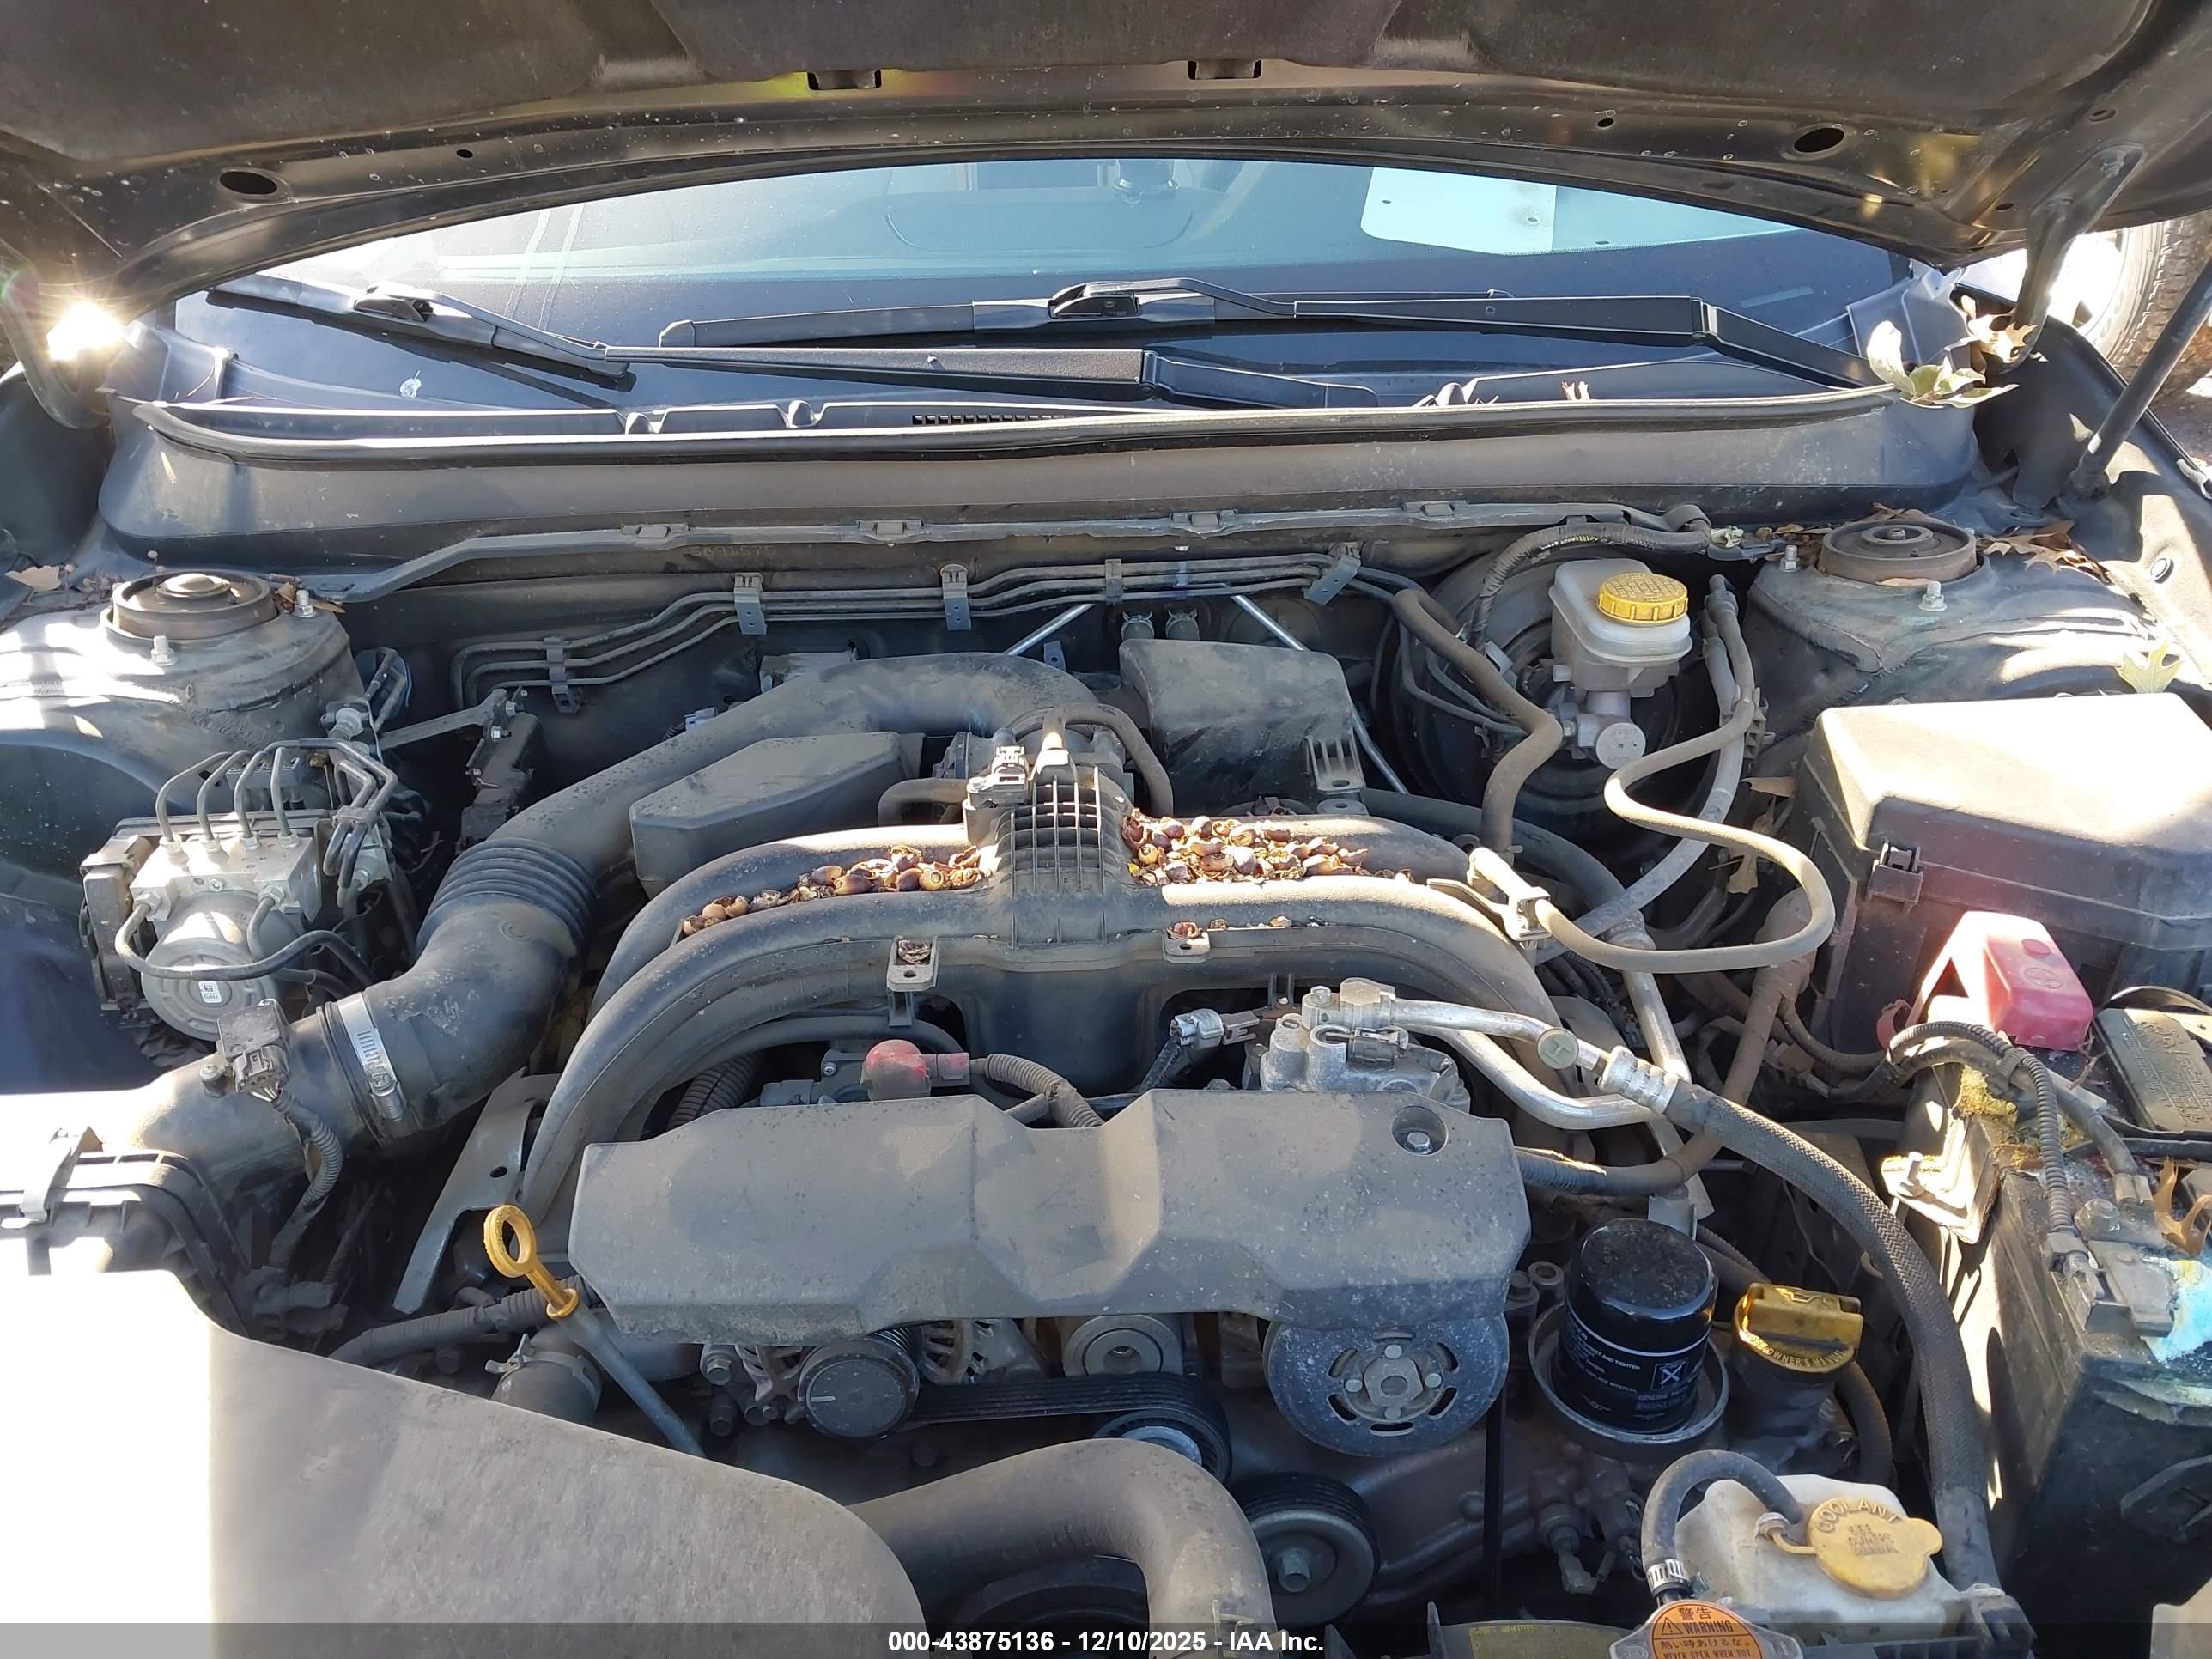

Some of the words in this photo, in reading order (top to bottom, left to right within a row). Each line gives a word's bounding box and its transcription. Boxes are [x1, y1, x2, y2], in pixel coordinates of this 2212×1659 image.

[1816, 1498, 1901, 1532] COOLANT
[1678, 1607, 1711, 1620] 警告
[1683, 1620, 1734, 1634] WARNING
